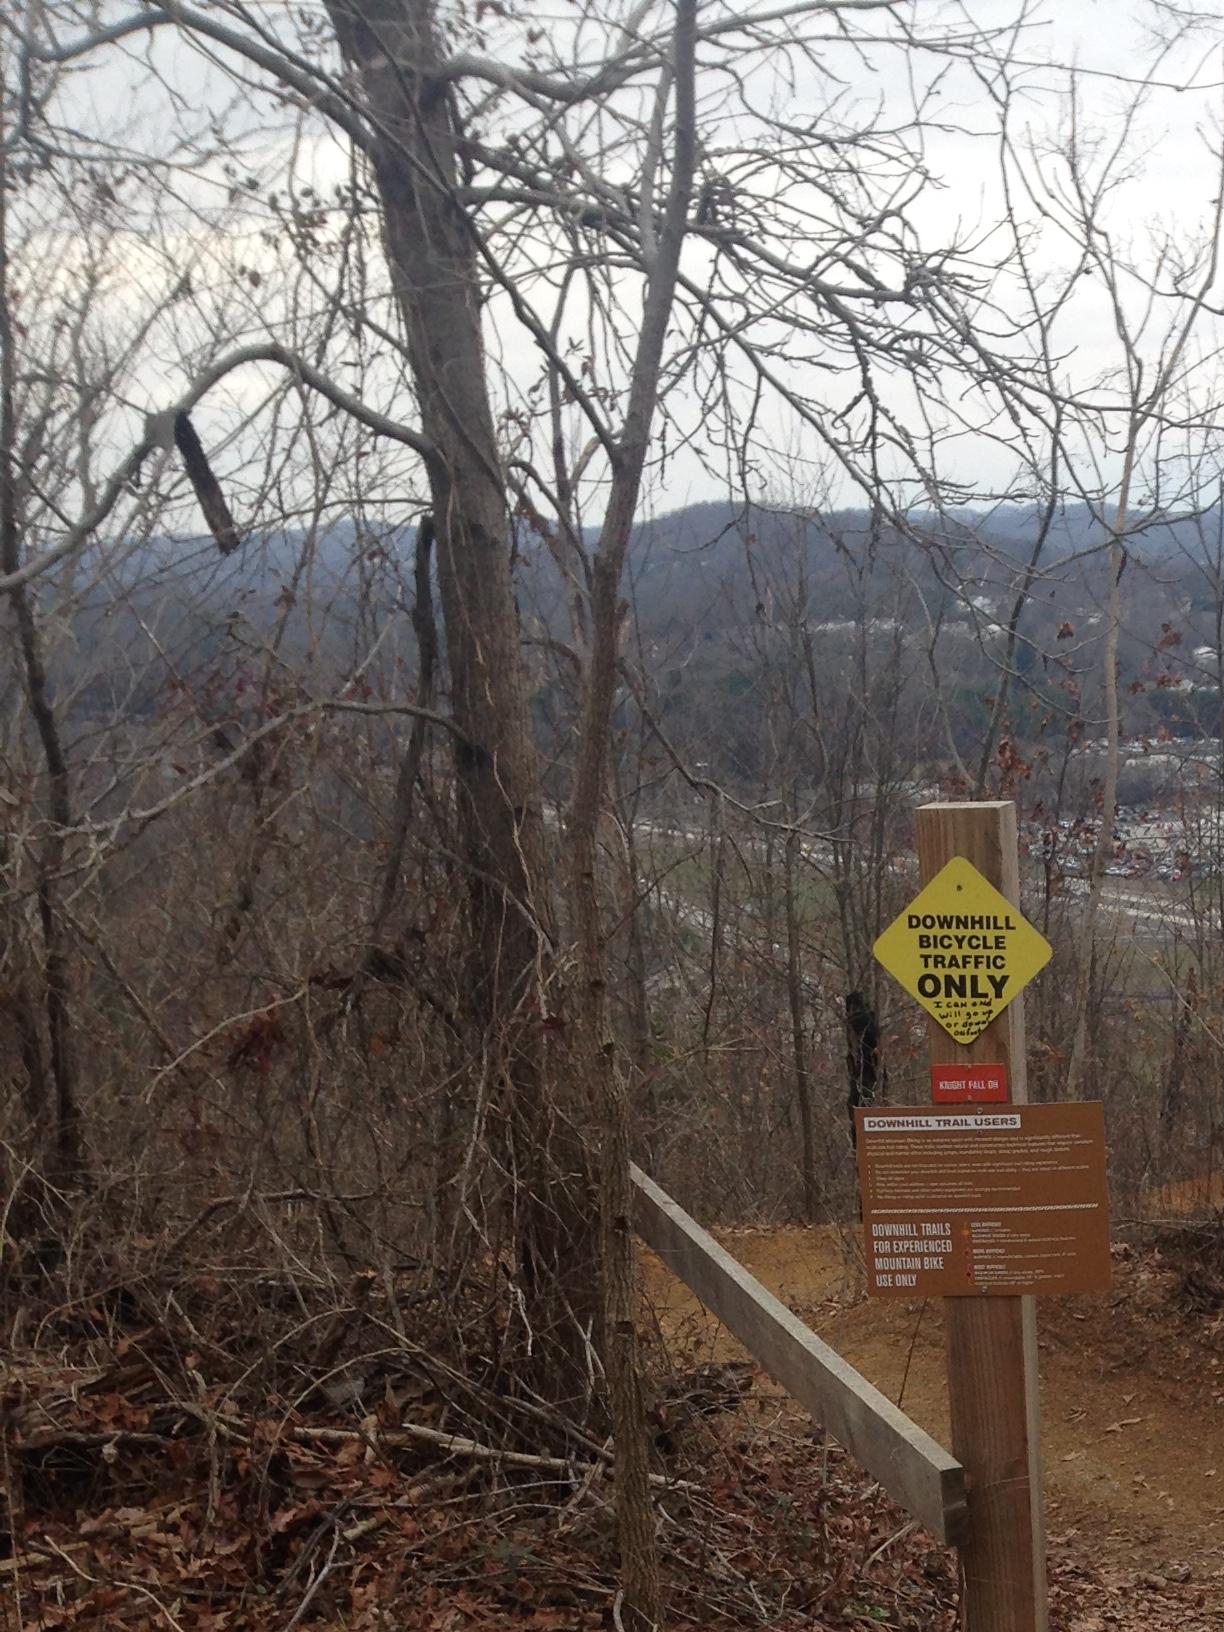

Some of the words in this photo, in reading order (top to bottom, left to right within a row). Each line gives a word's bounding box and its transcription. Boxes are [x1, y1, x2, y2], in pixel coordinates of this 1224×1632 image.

[908, 915, 1016, 930] DOWNHILL
[919, 935, 1006, 950] BICYCLE
[919, 954, 1006, 970] TRAFFIC
[917, 973, 1010, 999] ONLY
[867, 1119, 932, 1128] DOWNHILL
[935, 1118, 971, 1127] TRAIL
[974, 1117, 1017, 1126] USERS
[872, 1223, 919, 1237] DOWNHILL
[920, 1223, 951, 1236] TRAILS
[873, 1240, 891, 1253] FOR
[893, 1239, 953, 1253] EXPERIENCED
[874, 1257, 921, 1270] MOUNTAIN
[923, 1256, 945, 1270] BIKE
[876, 1274, 893, 1287] USE
[895, 1273, 917, 1287] ONLY
